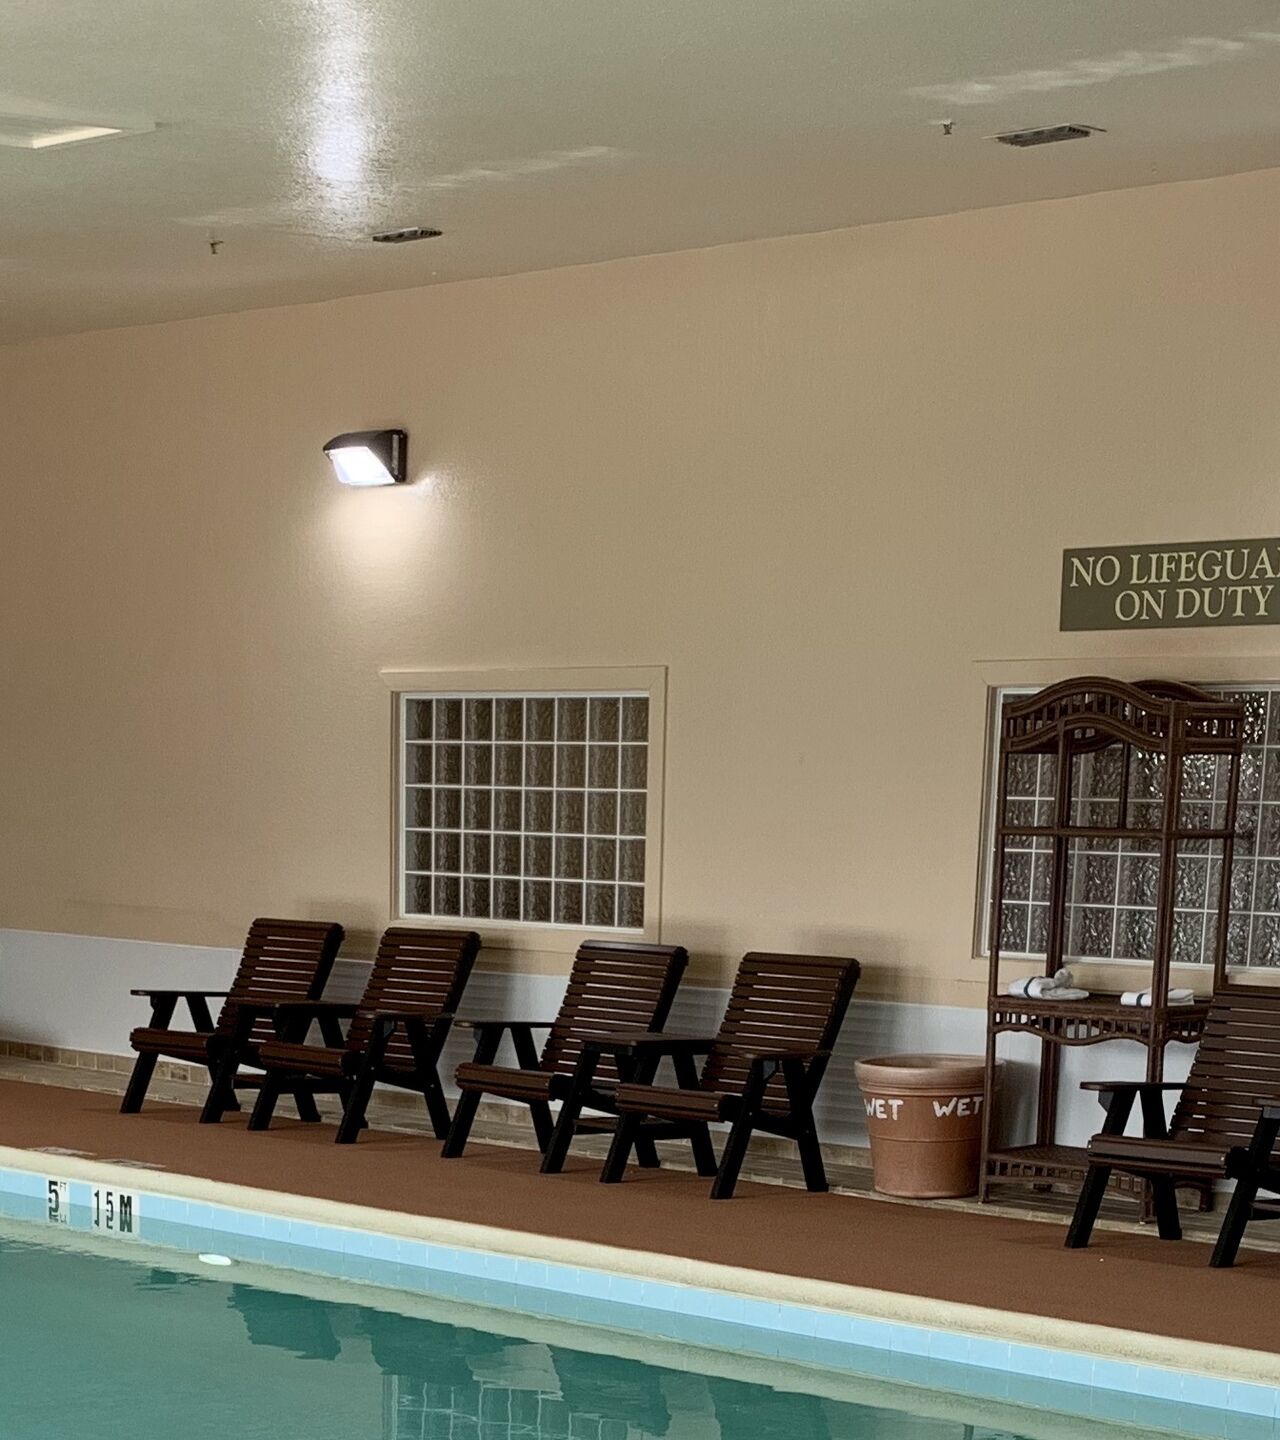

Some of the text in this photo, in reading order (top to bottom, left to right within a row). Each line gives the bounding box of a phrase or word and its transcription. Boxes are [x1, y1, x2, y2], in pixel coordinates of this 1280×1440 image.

[1070, 555, 1121, 587] NO
[1115, 585, 1274, 621] ON DUTY
[863, 1096, 984, 1120] WET WET
[48, 1180, 68, 1206] 5 FT
